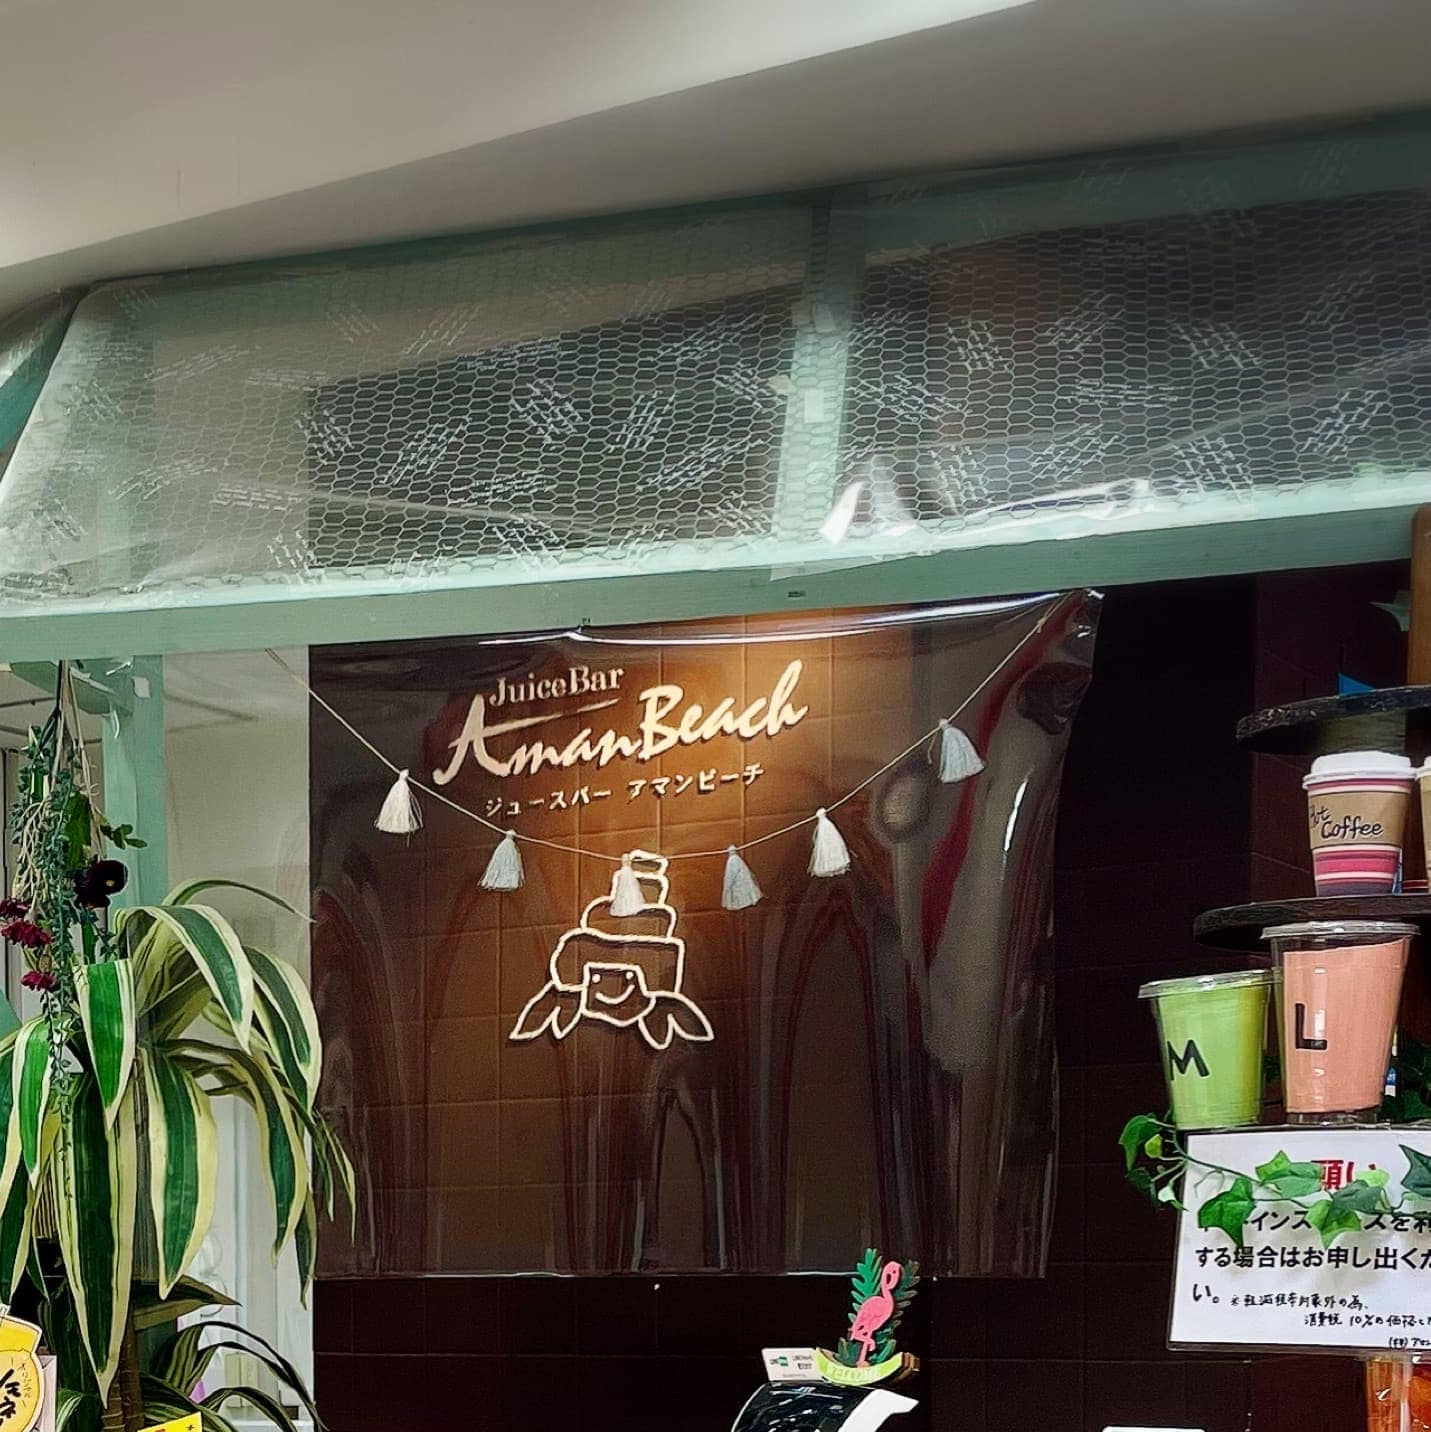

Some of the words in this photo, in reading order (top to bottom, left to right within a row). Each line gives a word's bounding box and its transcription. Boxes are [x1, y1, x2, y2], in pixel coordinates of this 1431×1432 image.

[489, 665, 624, 707] JuiceBar
[1321, 815, 1384, 839] Coffee
[1295, 1003, 1328, 1051] L
[1167, 1039, 1210, 1081] M
